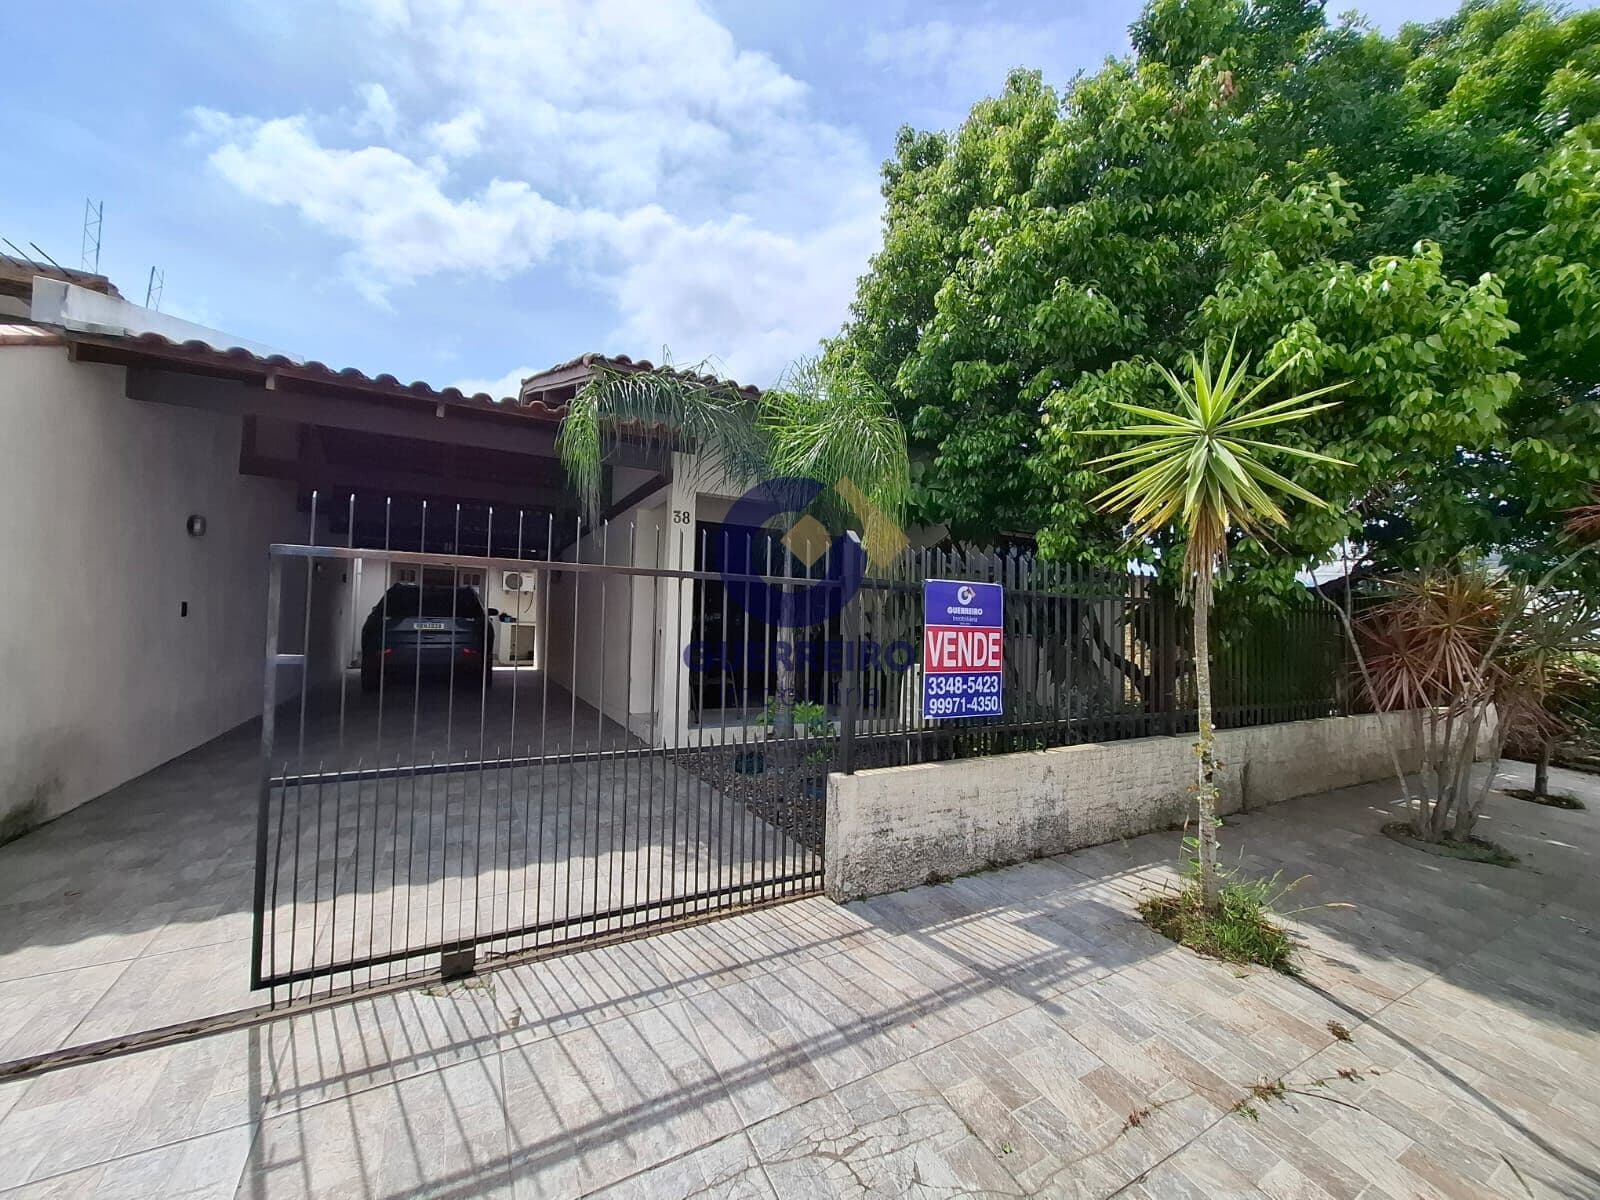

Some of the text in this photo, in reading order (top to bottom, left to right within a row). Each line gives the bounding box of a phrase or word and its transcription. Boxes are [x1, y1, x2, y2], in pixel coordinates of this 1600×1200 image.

[673, 510, 690, 525] 38
[947, 606, 983, 616] GUERREIRO
[927, 630, 1001, 668] VENDE
[928, 675, 998, 695] 3348-5423
[929, 695, 998, 715] 99971-4350
